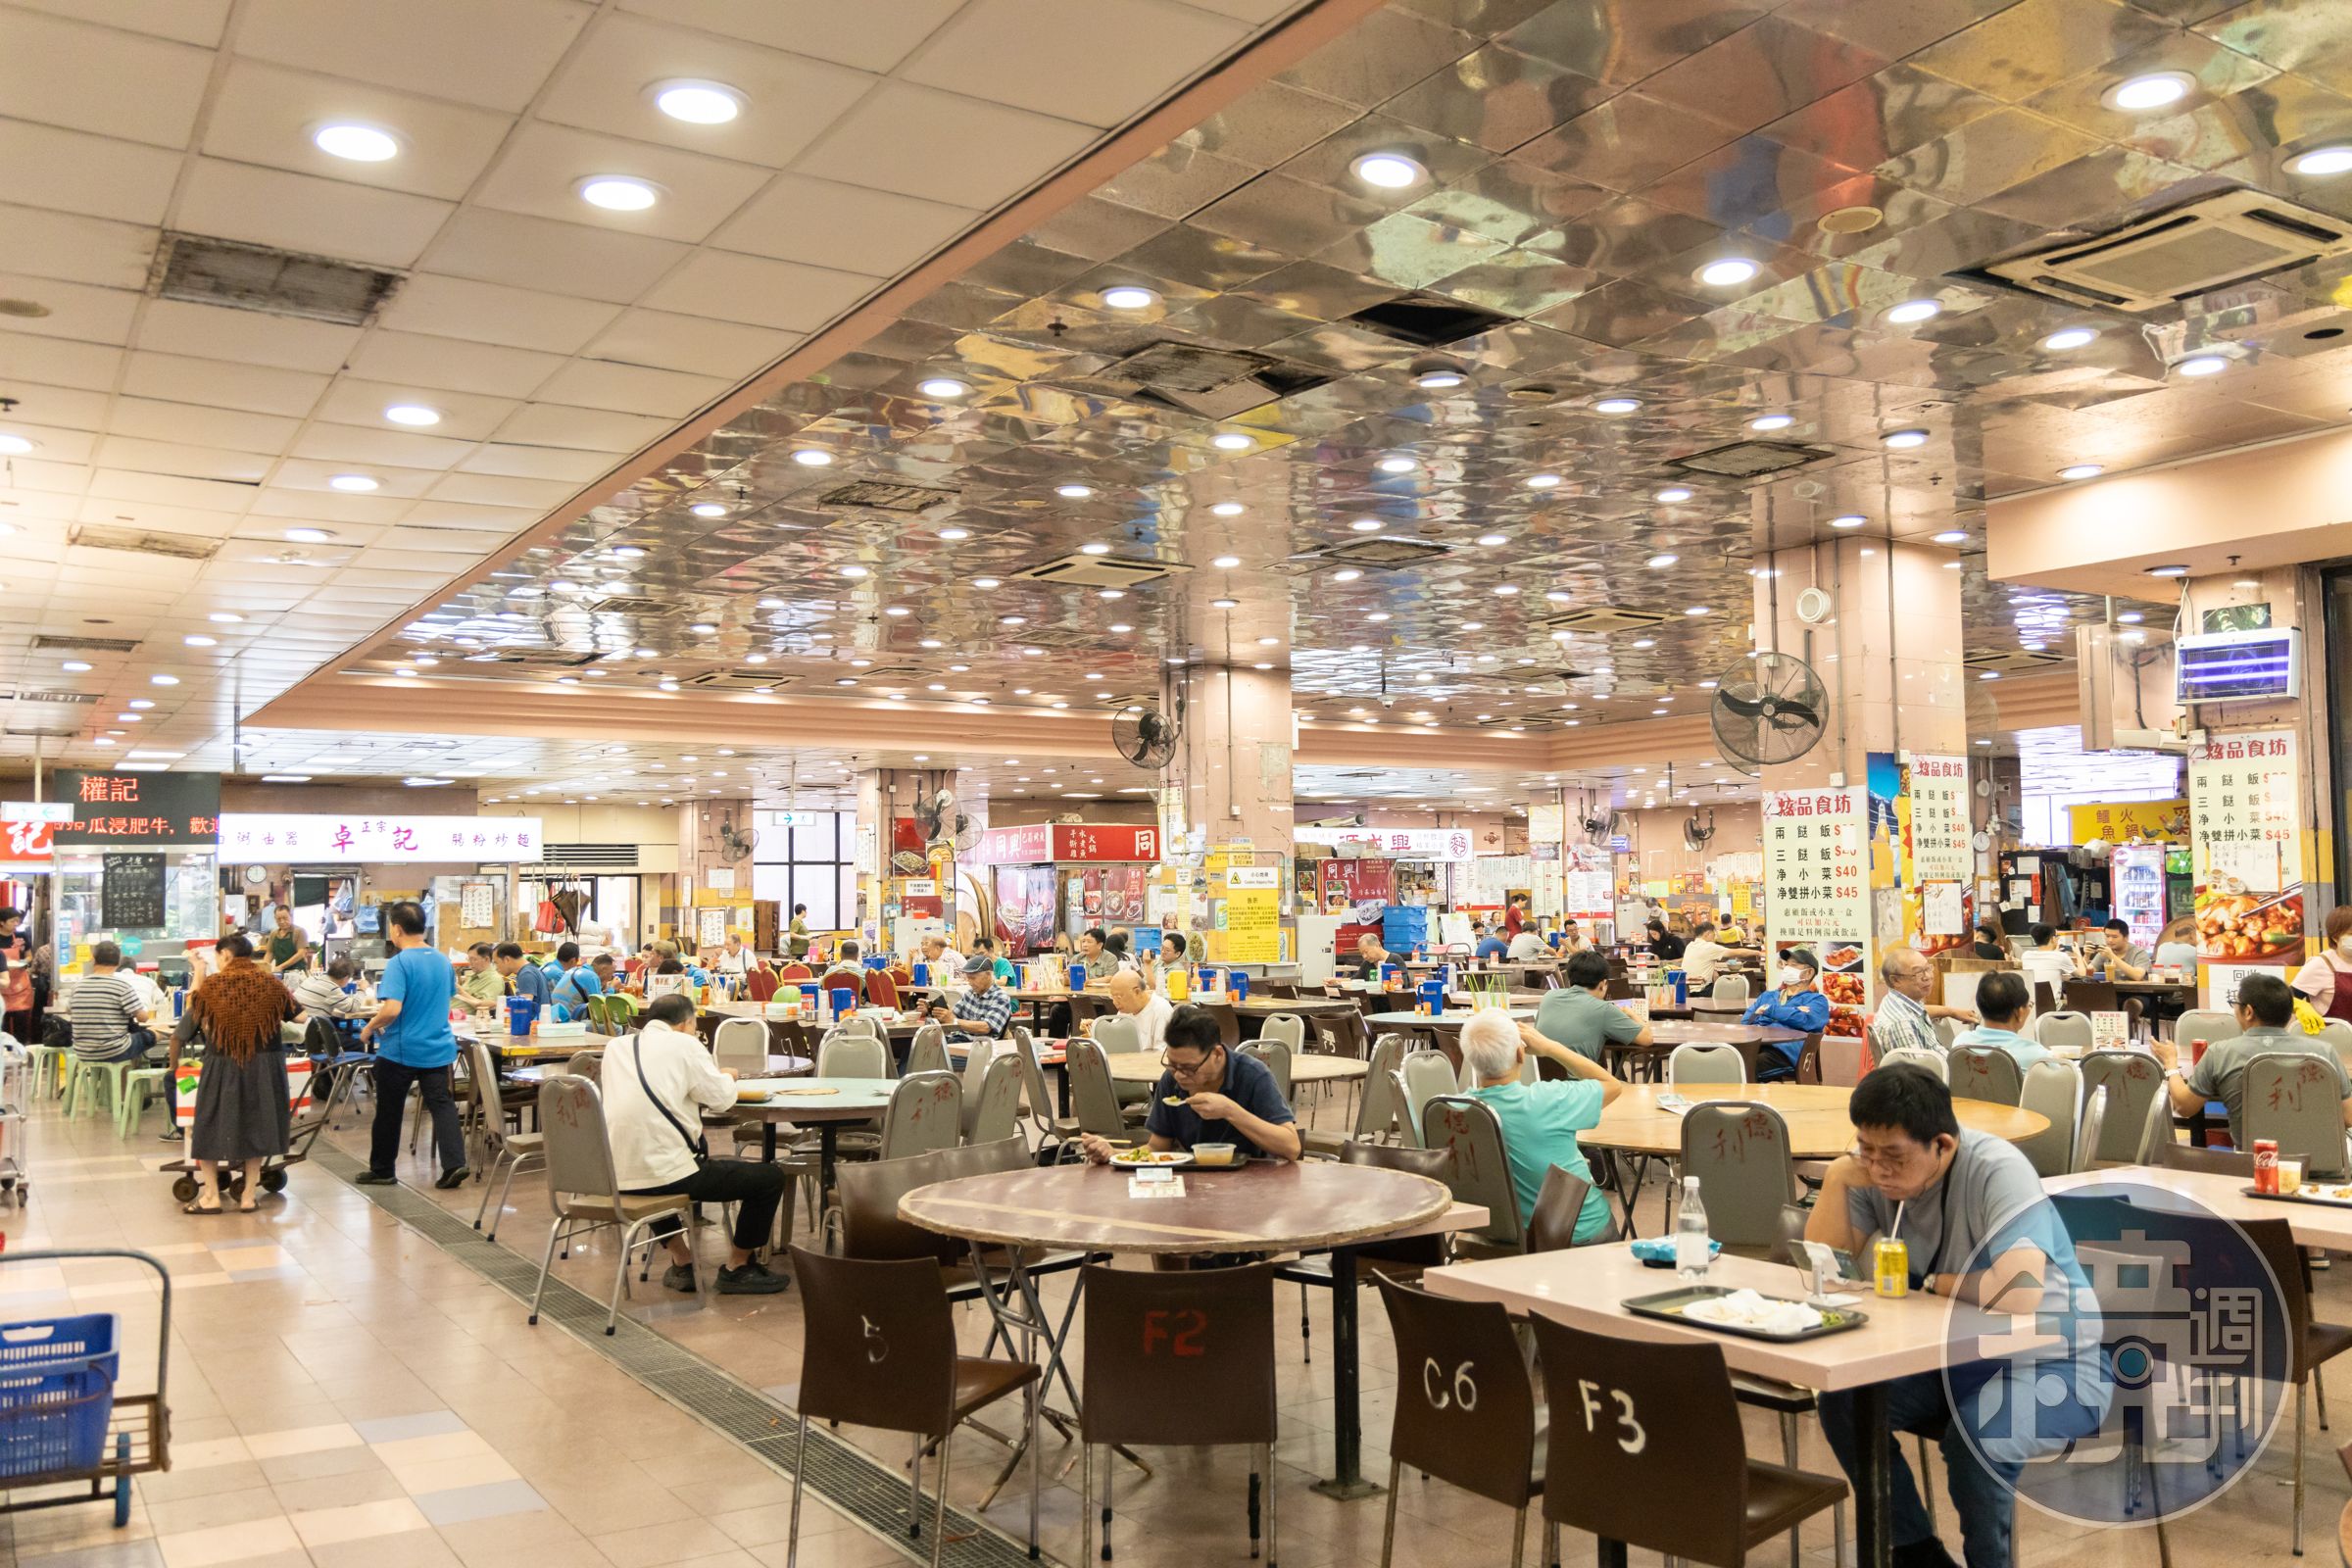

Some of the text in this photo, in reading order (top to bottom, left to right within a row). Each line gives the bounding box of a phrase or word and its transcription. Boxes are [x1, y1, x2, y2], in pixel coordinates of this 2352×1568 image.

[80, 776, 138, 802] 權記
[7, 820, 53, 855] 記
[331, 824, 418, 854] 卓記
[1952, 823, 1965, 833] $40
[2265, 829, 2290, 841] $45
[1135, 829, 1155, 858] 同
[1836, 865, 1858, 878] $40
[1837, 886, 1858, 899] $45
[1145, 1309, 1206, 1356] F2
[1424, 1357, 1477, 1411] C6
[1579, 1379, 1646, 1454] F3
